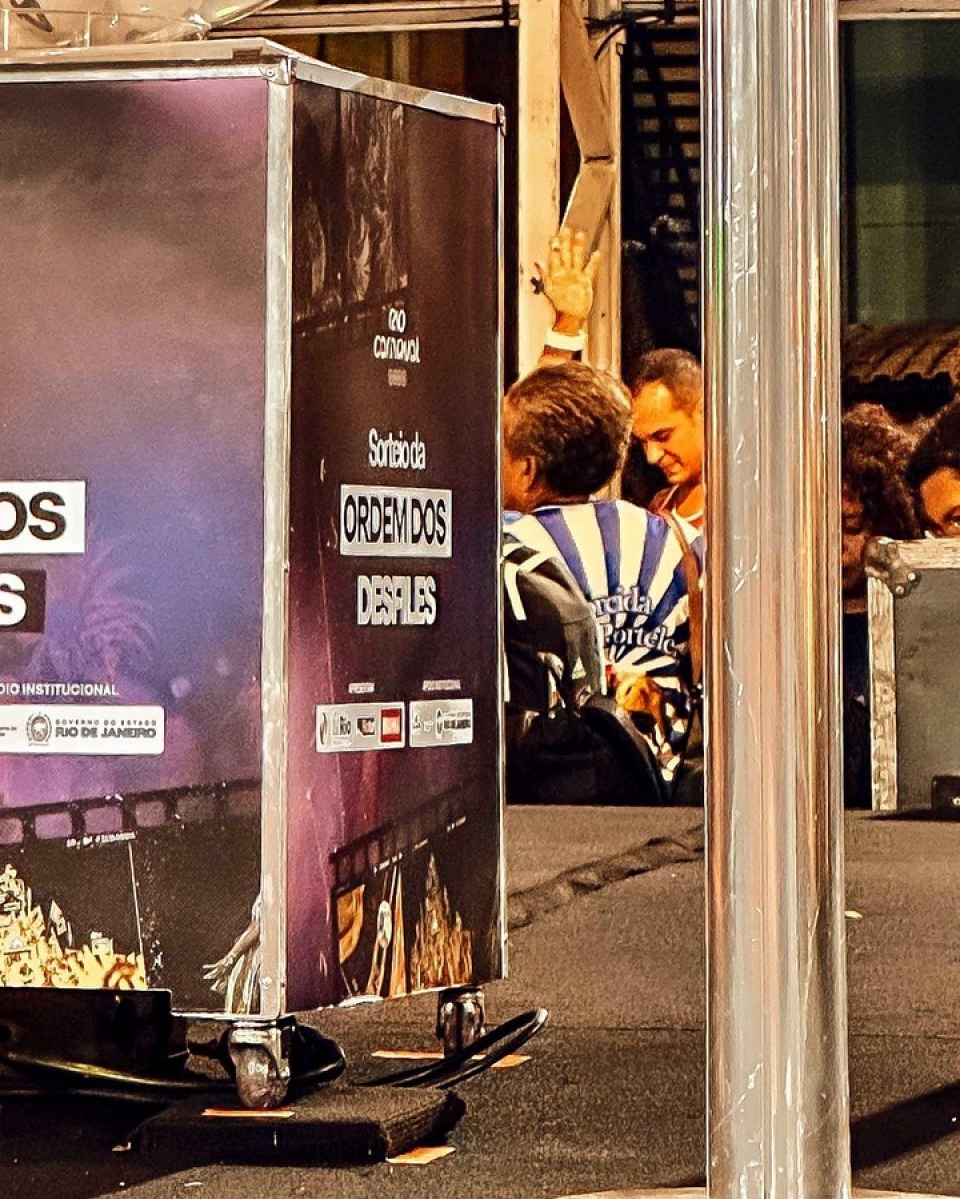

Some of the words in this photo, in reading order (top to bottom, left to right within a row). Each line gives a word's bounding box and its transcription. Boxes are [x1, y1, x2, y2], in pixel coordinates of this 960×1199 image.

[368, 427, 409, 469] Sorteio
[411, 431, 426, 470] da
[343, 494, 408, 544] ORDEM
[411, 498, 446, 545] DOS
[357, 575, 437, 626] DESFILES
[22, 683, 118, 696] INSTITUCIONAL
[55, 727, 79, 739] RIO
[81, 727, 98, 739] DE
[101, 727, 157, 739] JANEIRO
